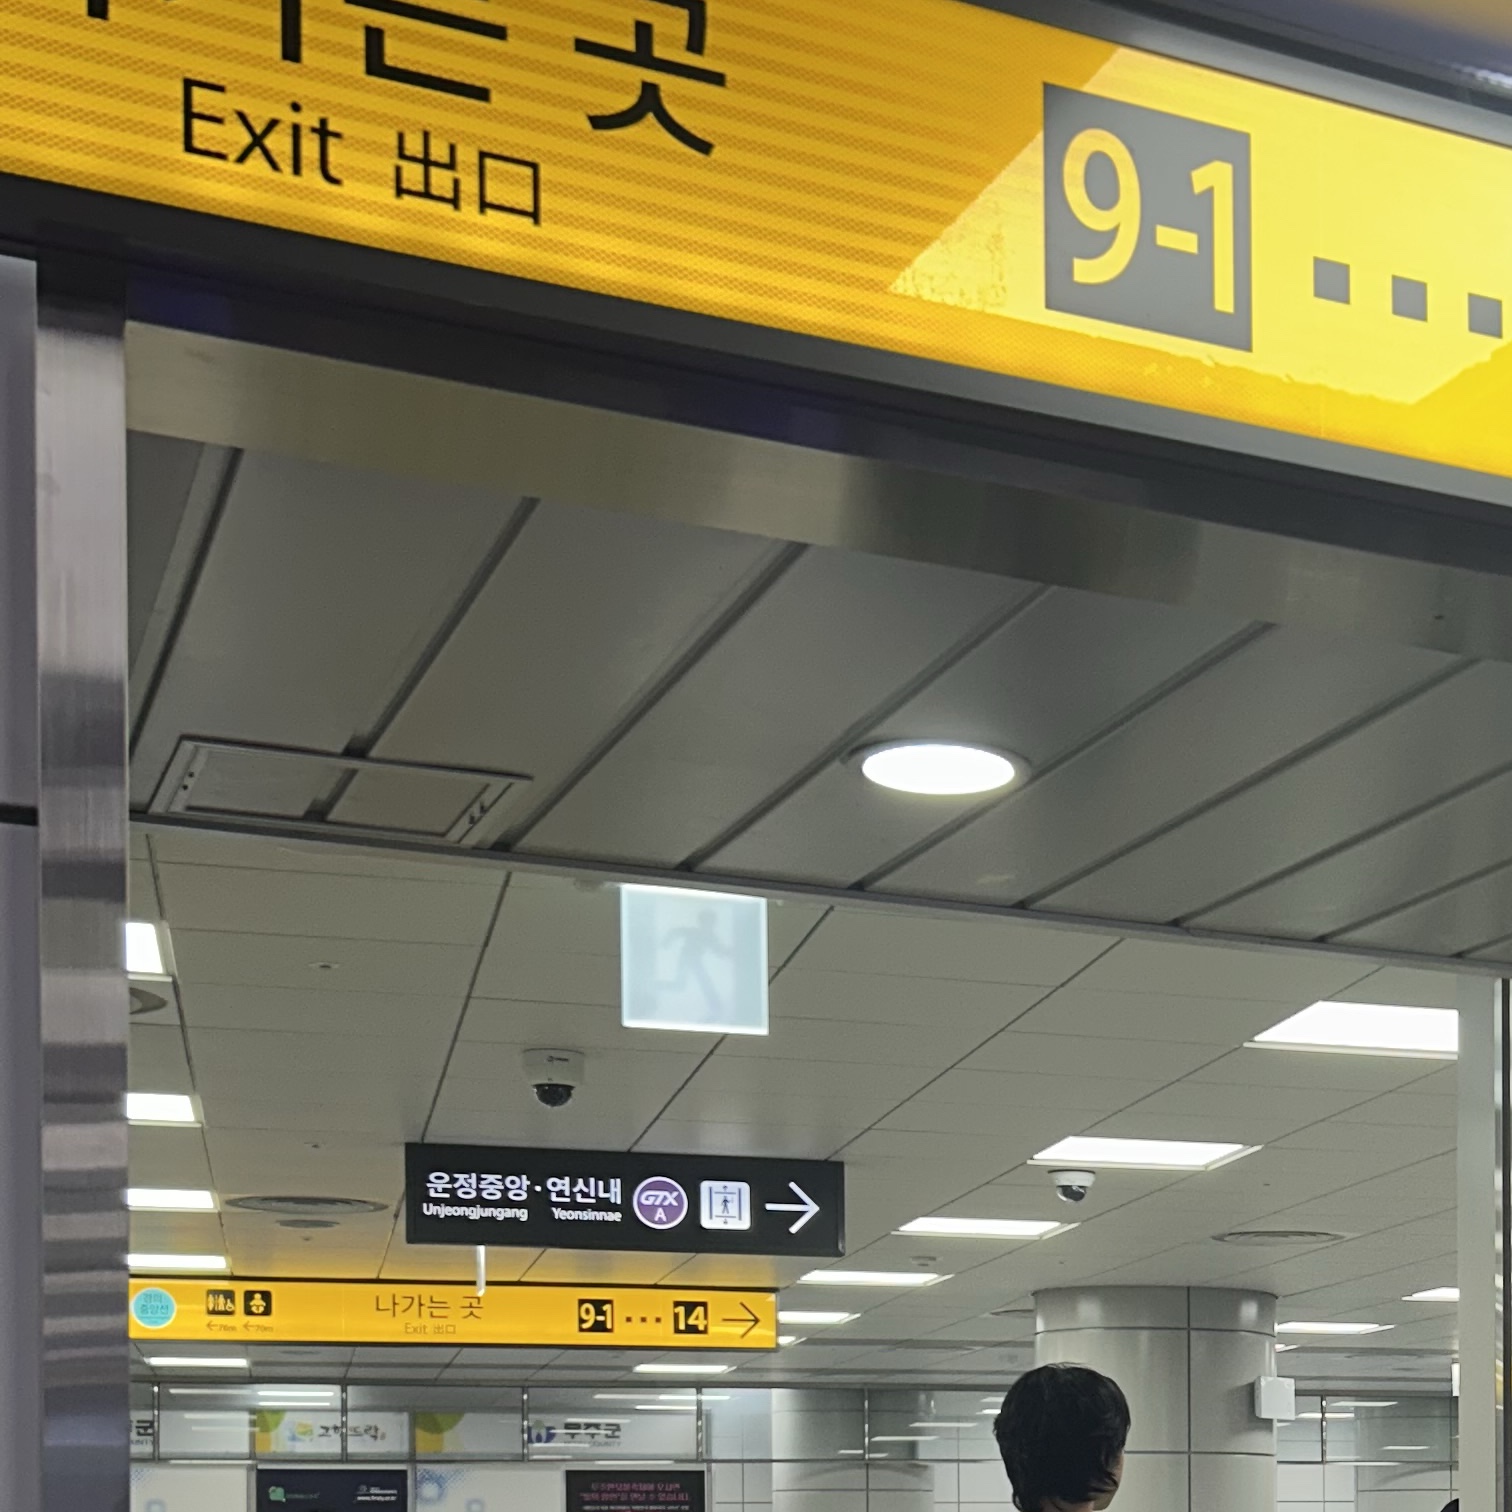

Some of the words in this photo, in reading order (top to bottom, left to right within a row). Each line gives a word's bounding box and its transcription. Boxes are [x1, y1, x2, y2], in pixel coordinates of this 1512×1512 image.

[573, 0, 727, 157] 곳
[182, 77, 344, 187] Exit
[394, 130, 542, 226] 出口
[1060, 126, 1237, 315] 9-1
[638, 1189, 682, 1208] GTX
[423, 1202, 528, 1222] Unjeongjungang
[552, 1206, 622, 1223] Yeonsinnae
[654, 1207, 667, 1222] A
[375, 1293, 451, 1319] 나가는
[460, 1295, 483, 1319] 곳
[579, 1302, 614, 1330] 9-1
[673, 1305, 707, 1331] 14
[404, 1322, 428, 1335] Exit
[433, 1323, 456, 1335] 出口
[564, 1422, 622, 1439] 무주군
